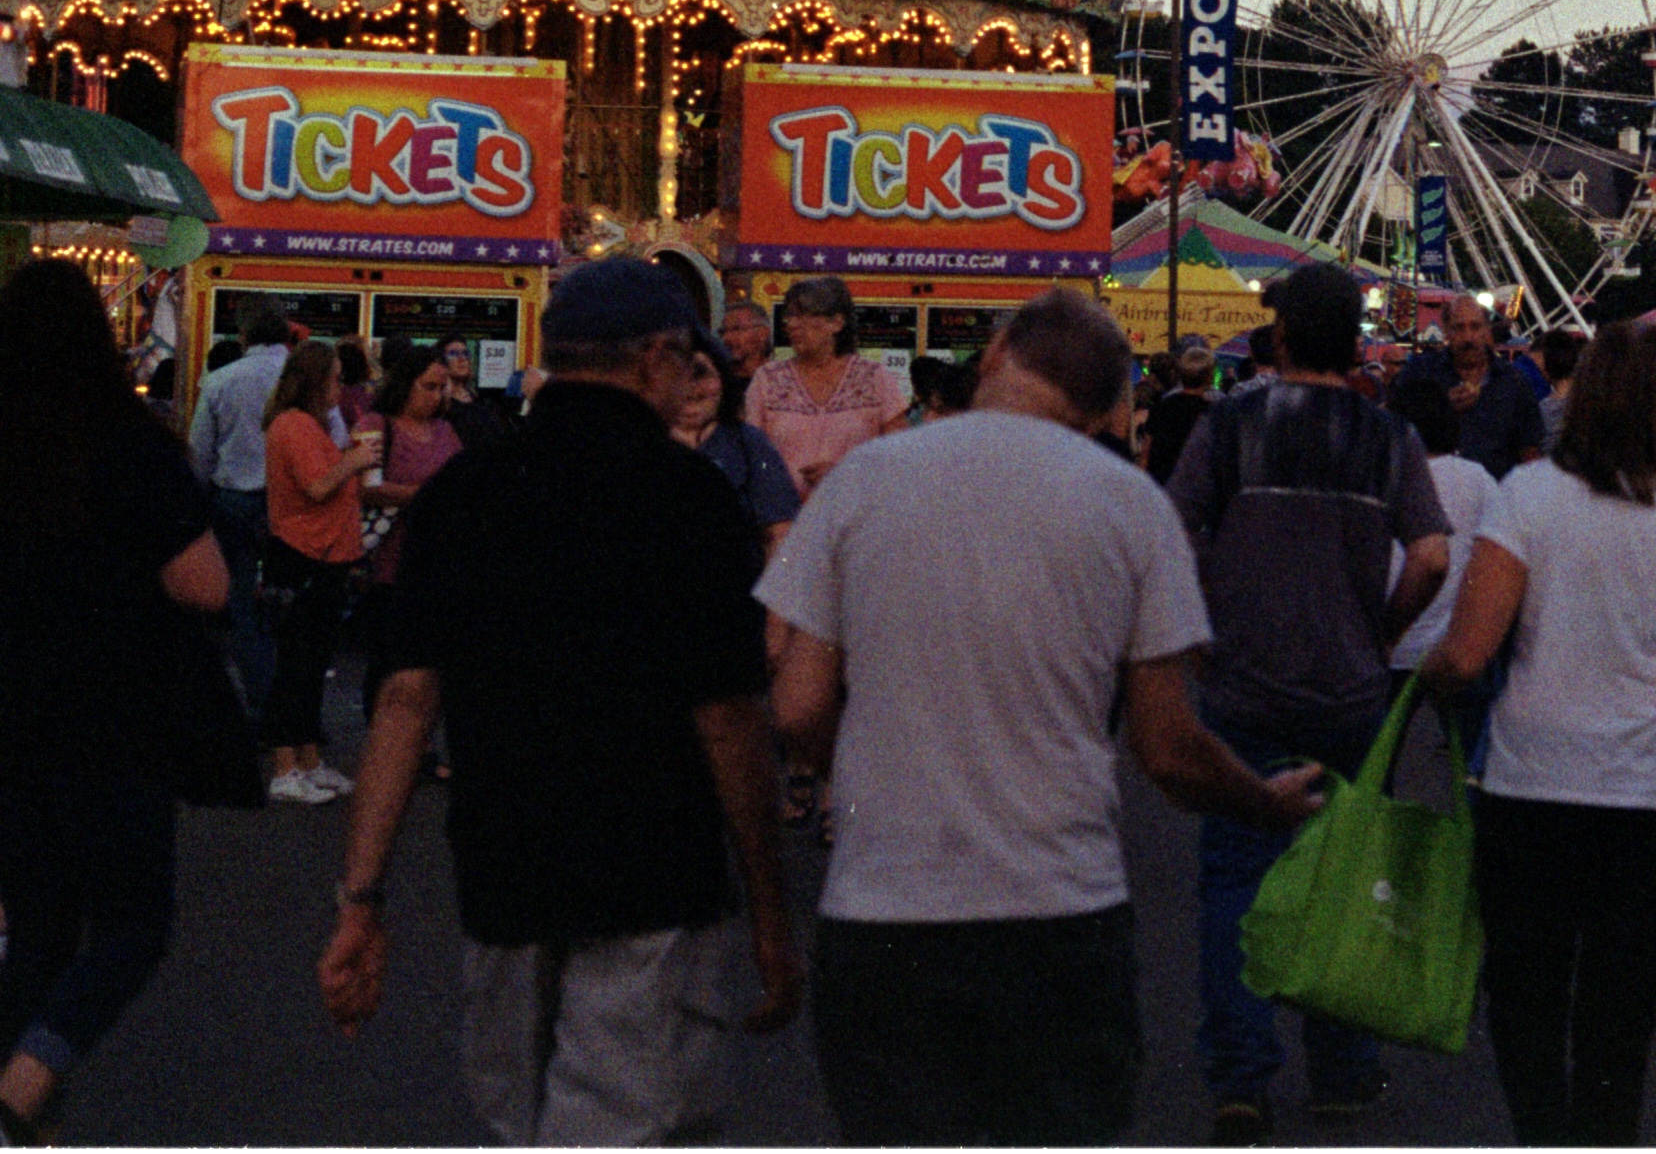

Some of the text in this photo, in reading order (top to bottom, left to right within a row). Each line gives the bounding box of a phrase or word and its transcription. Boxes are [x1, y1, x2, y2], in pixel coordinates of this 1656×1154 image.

[213, 88, 531, 215] TICKETS
[771, 105, 1084, 228] TICKETS
[287, 234, 454, 256] WWW.STRATES.COM
[1199, 302, 1267, 323] Tattoos
[485, 347, 505, 358] $30
